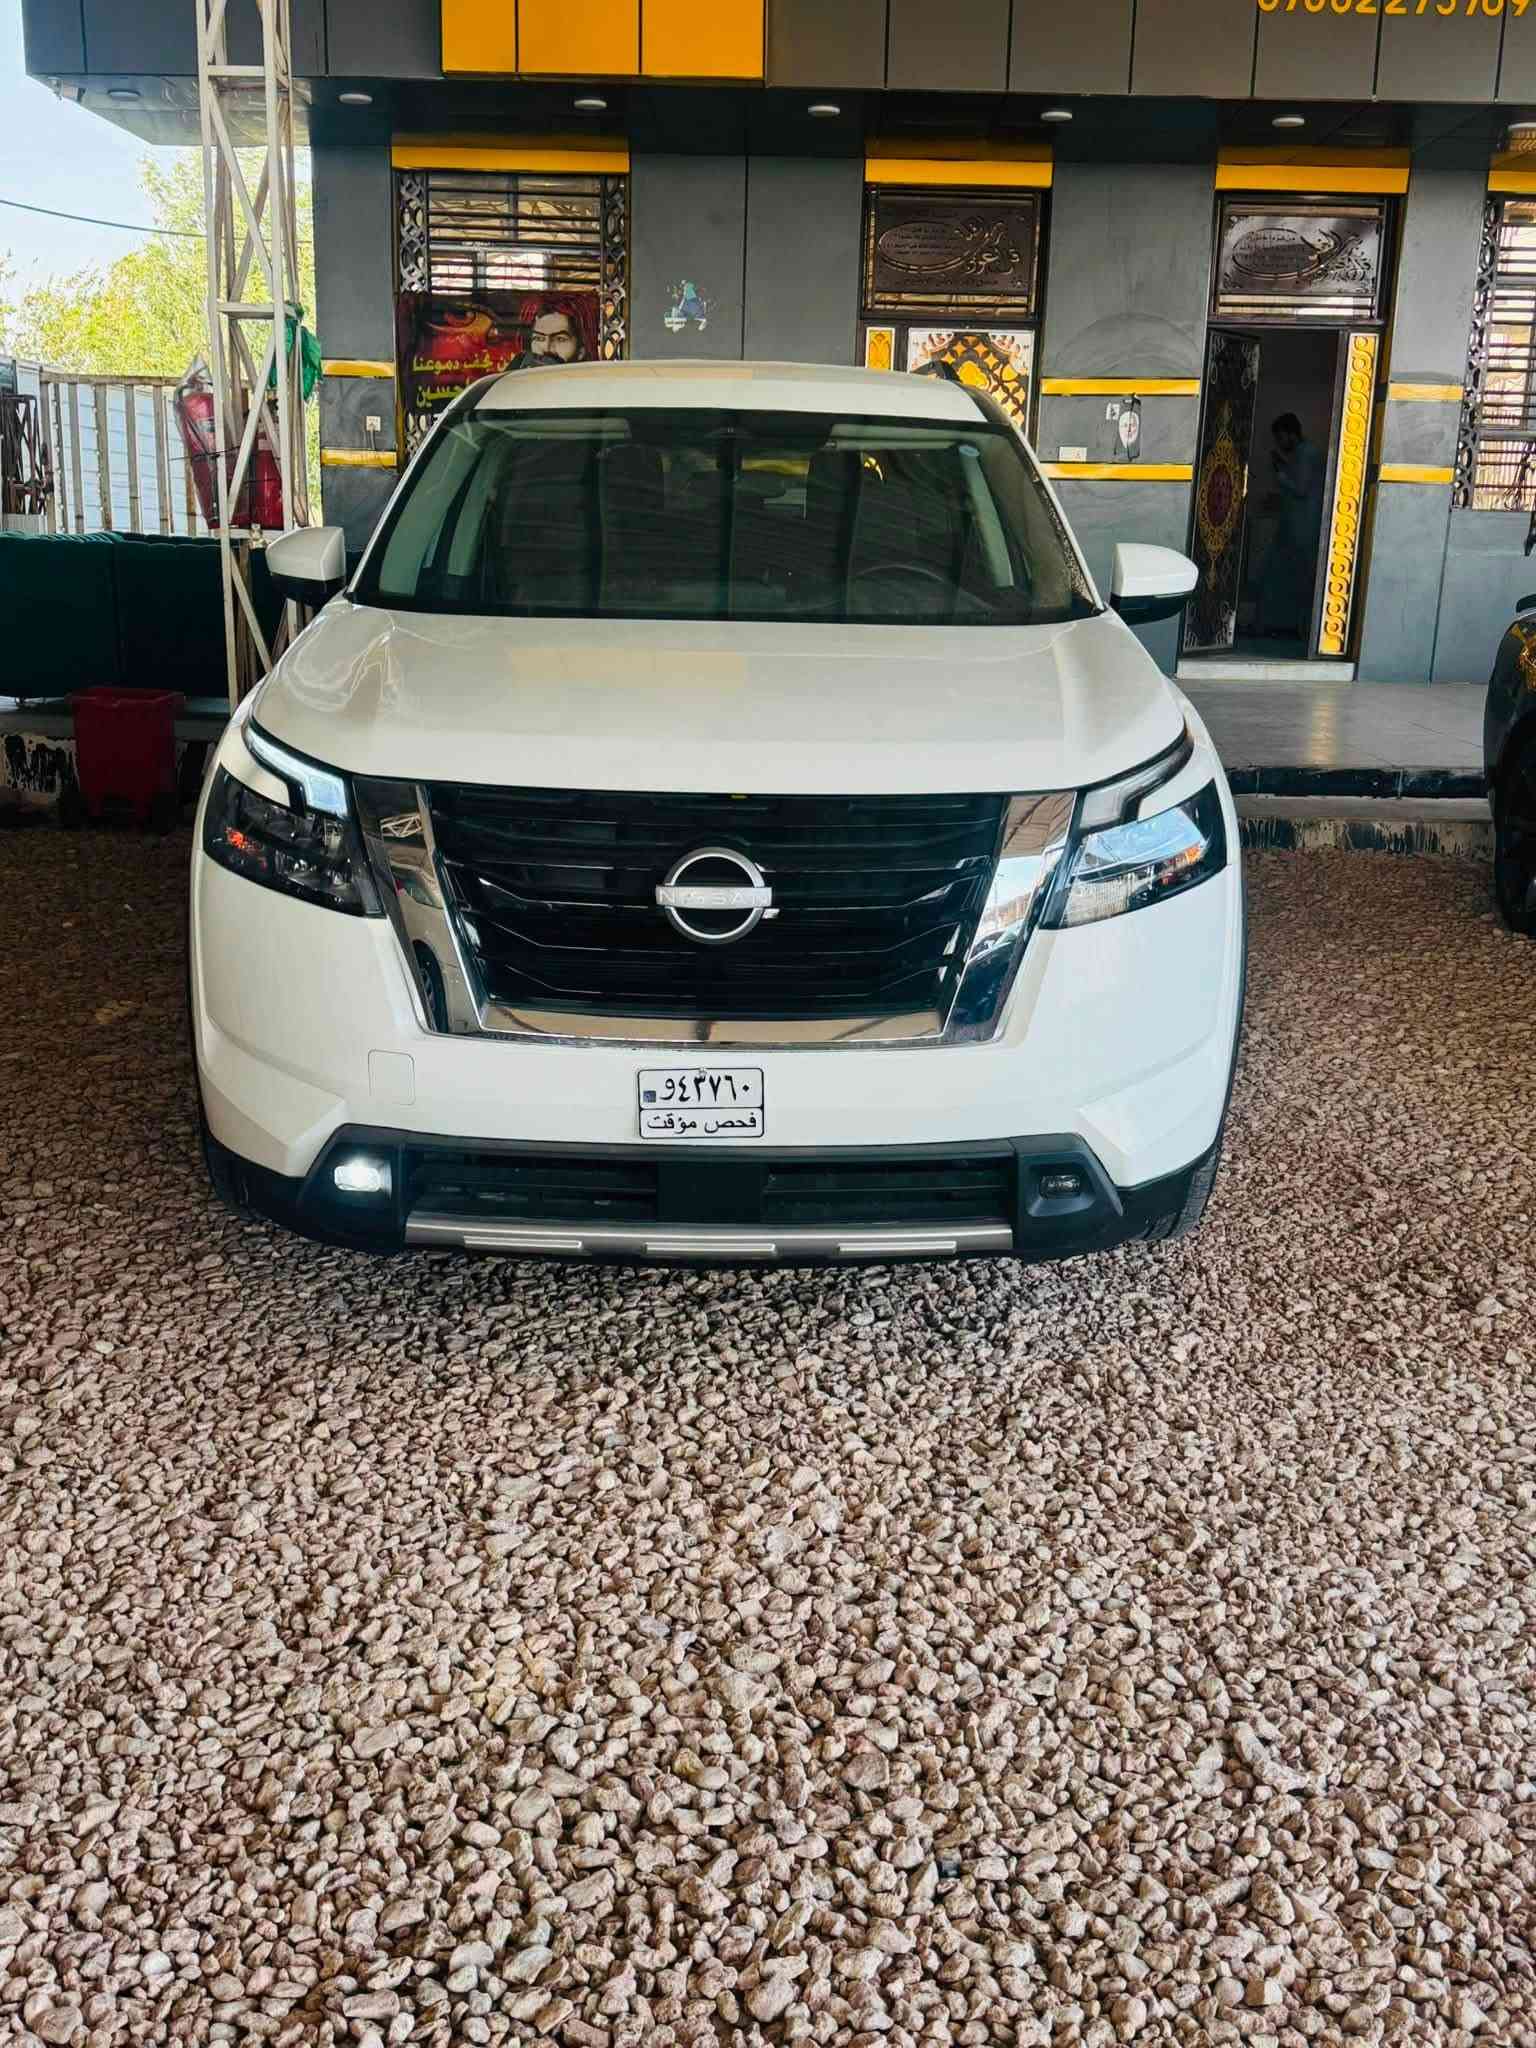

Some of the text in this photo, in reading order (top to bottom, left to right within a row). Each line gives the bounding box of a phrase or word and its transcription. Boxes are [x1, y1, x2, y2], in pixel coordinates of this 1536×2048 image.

[412, 356, 460, 375] دموعنا
[647, 1112, 757, 1135] فحص مؤقت
